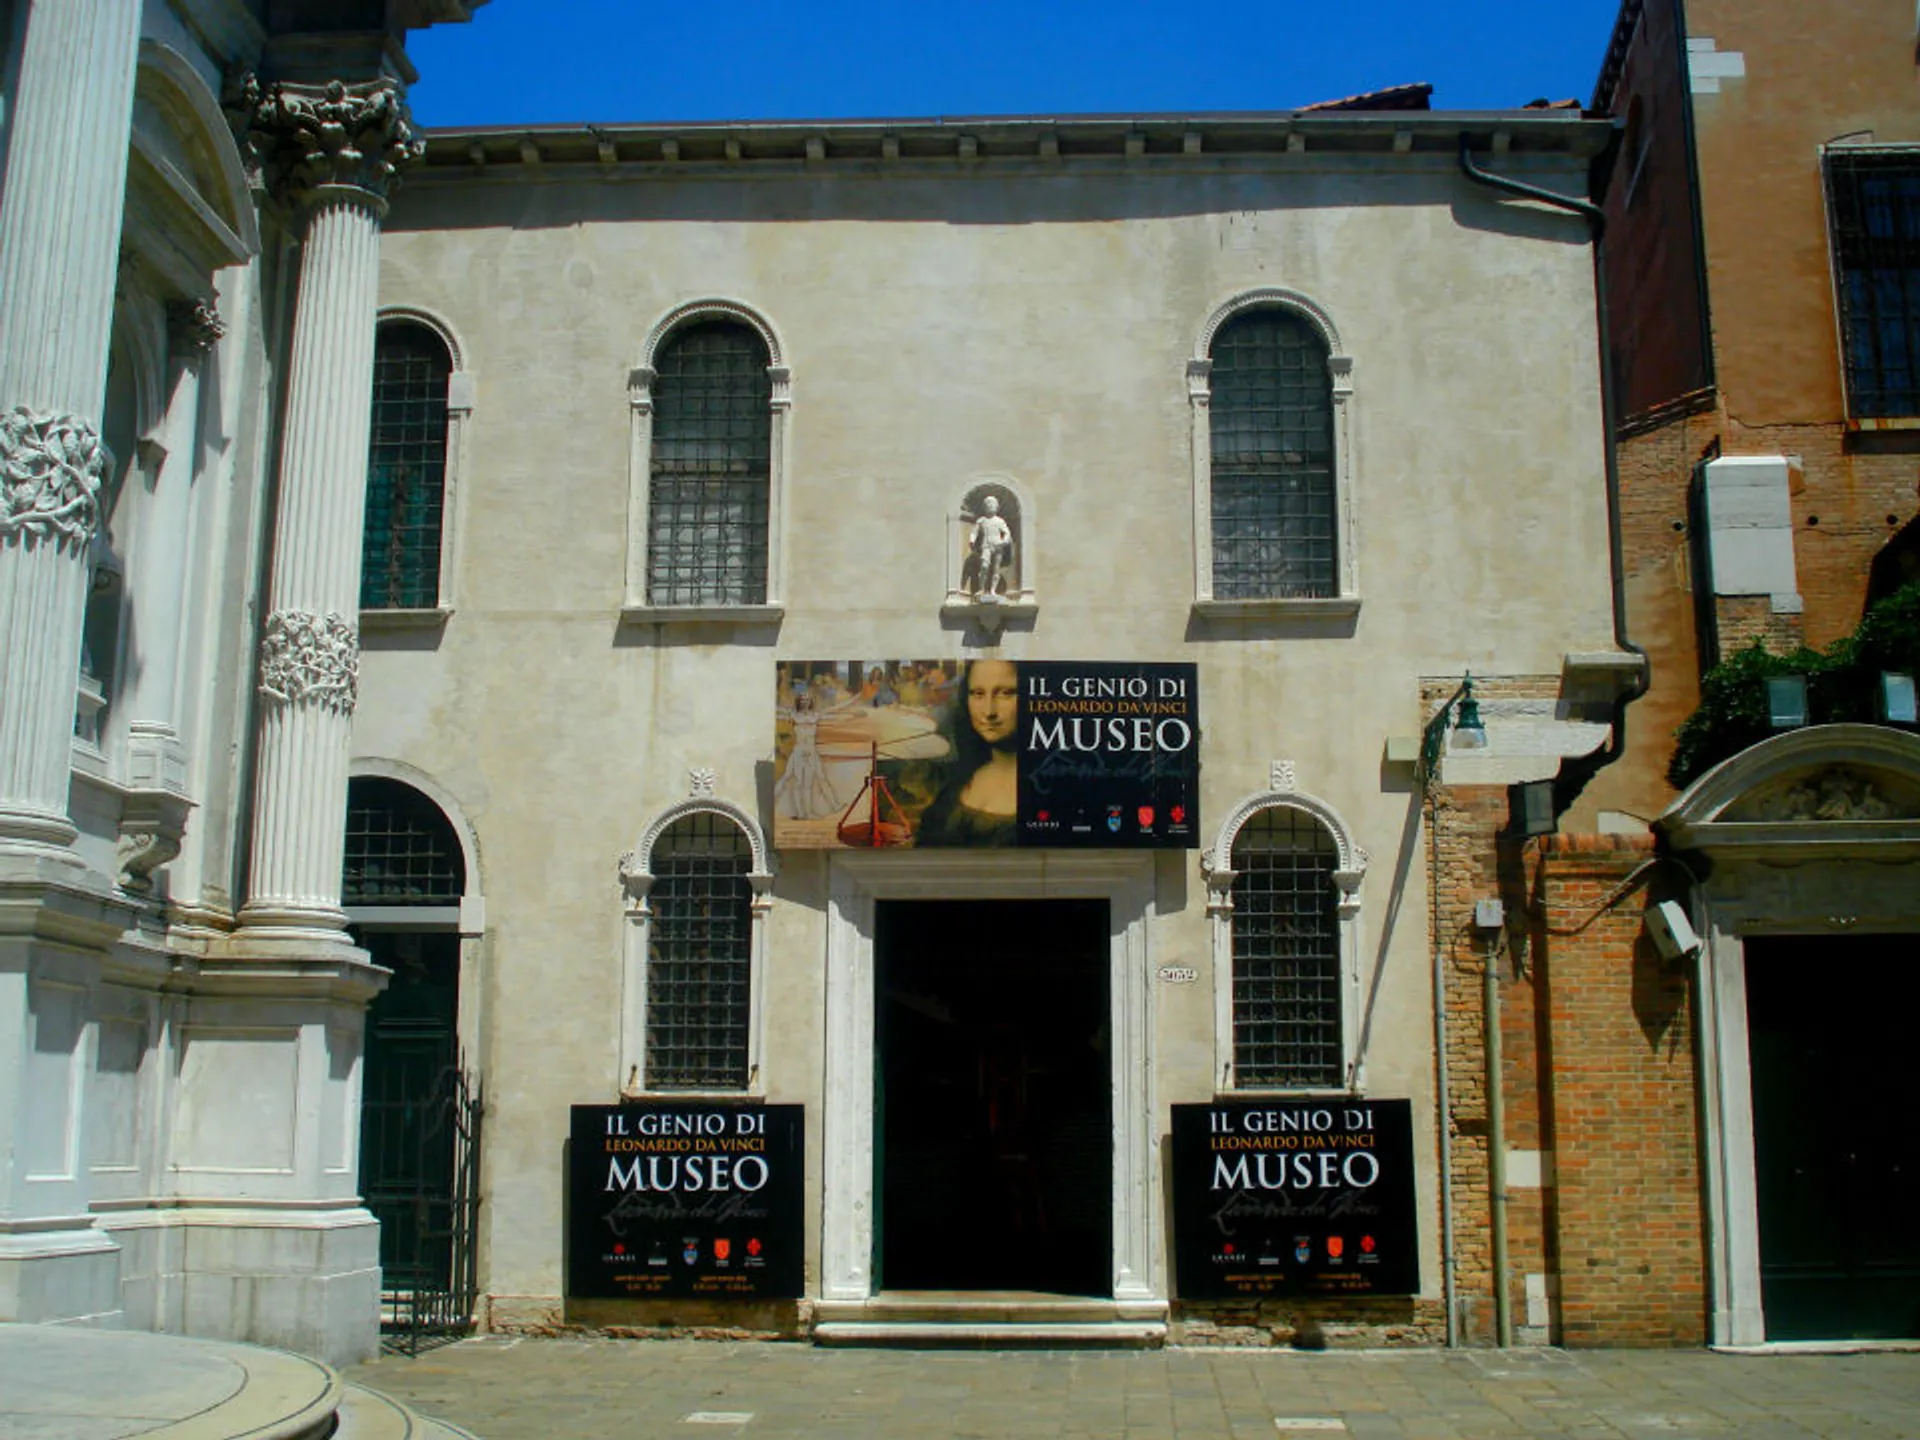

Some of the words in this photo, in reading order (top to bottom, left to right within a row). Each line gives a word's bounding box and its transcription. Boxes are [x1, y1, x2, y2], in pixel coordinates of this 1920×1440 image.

[1028, 677, 1051, 696] IL
[1061, 677, 1148, 697] GENIO
[1159, 678, 1186, 697] DI
[1029, 700, 1114, 714] LEONARDO
[1117, 701, 1141, 714] DA
[1143, 701, 1187, 714] VINCI
[1027, 715, 1192, 752] MUSEO
[605, 1114, 629, 1135] IL
[638, 1114, 725, 1135] GENIO
[736, 1114, 765, 1134] DI
[1209, 1112, 1234, 1133] IL
[1243, 1110, 1333, 1133] GENIO
[1344, 1110, 1374, 1130] DI
[605, 1139, 691, 1152] LEONARDO
[695, 1139, 717, 1152] DA
[720, 1138, 765, 1152] VINCI
[1210, 1135, 1298, 1150] LEONARDO
[1303, 1135, 1325, 1149] DA
[1328, 1134, 1375, 1148] VINCI
[604, 1155, 769, 1192] MUSEO
[1209, 1151, 1380, 1190] MUSEO
